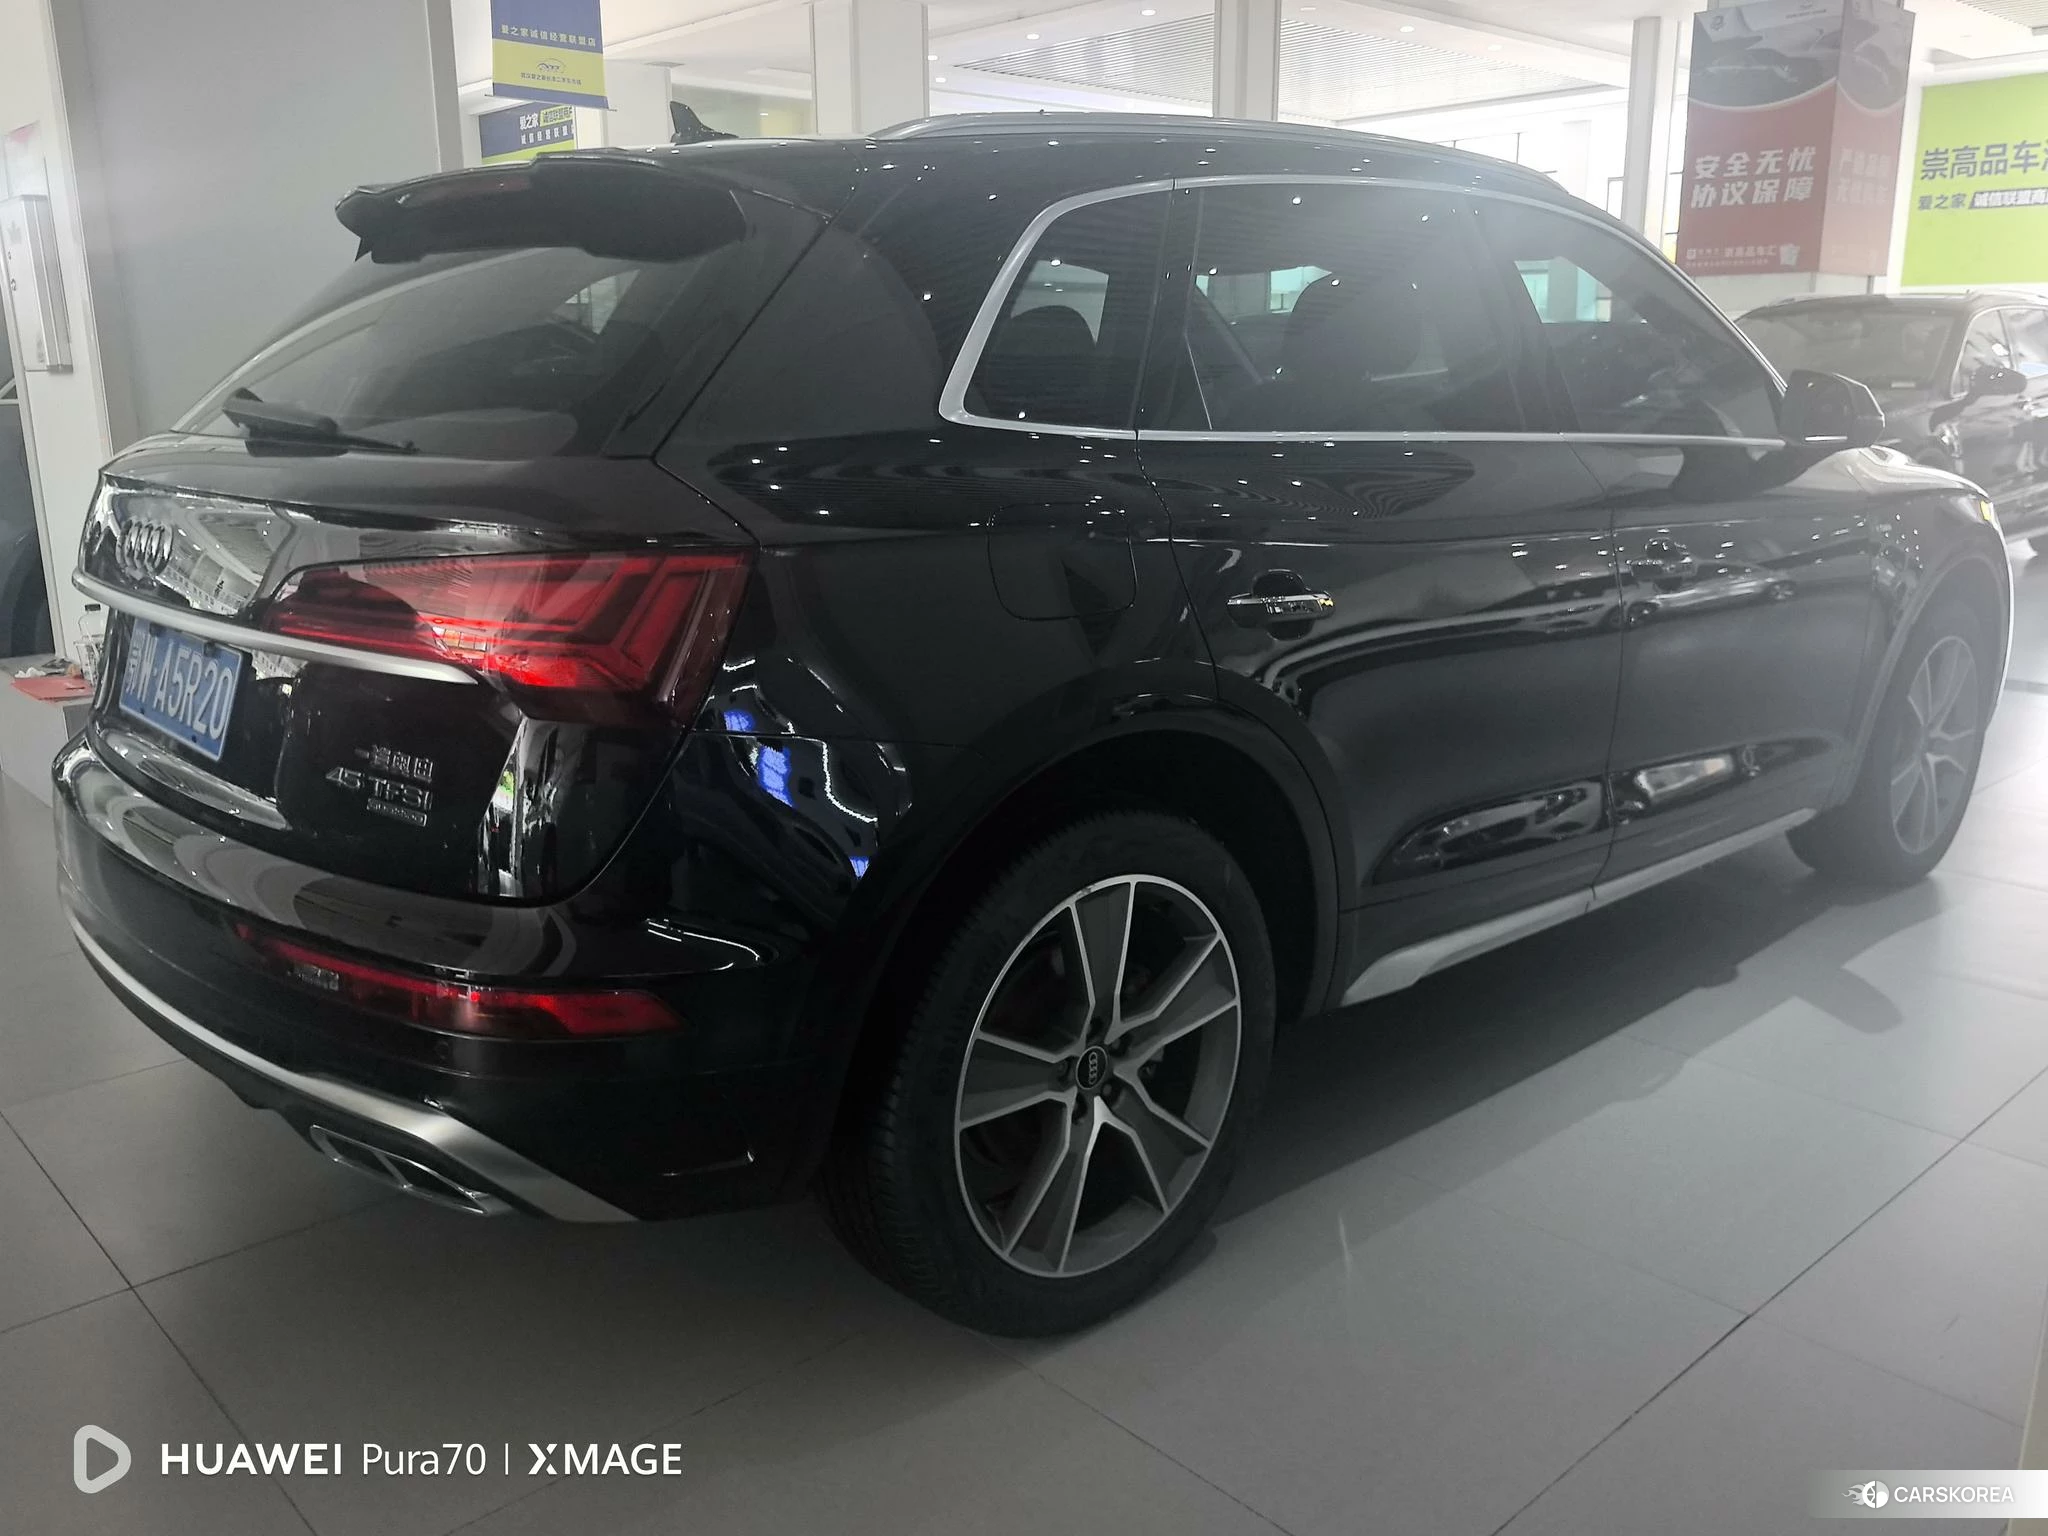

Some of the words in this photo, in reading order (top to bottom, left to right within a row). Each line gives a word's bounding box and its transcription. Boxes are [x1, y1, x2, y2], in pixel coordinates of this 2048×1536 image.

[1694, 146, 1817, 180] 安全无忧
[1690, 176, 1815, 209] 协议保障
[1917, 192, 1967, 211] 爱之家
[325, 766, 362, 790] 45
[368, 775, 433, 811] TFSI
